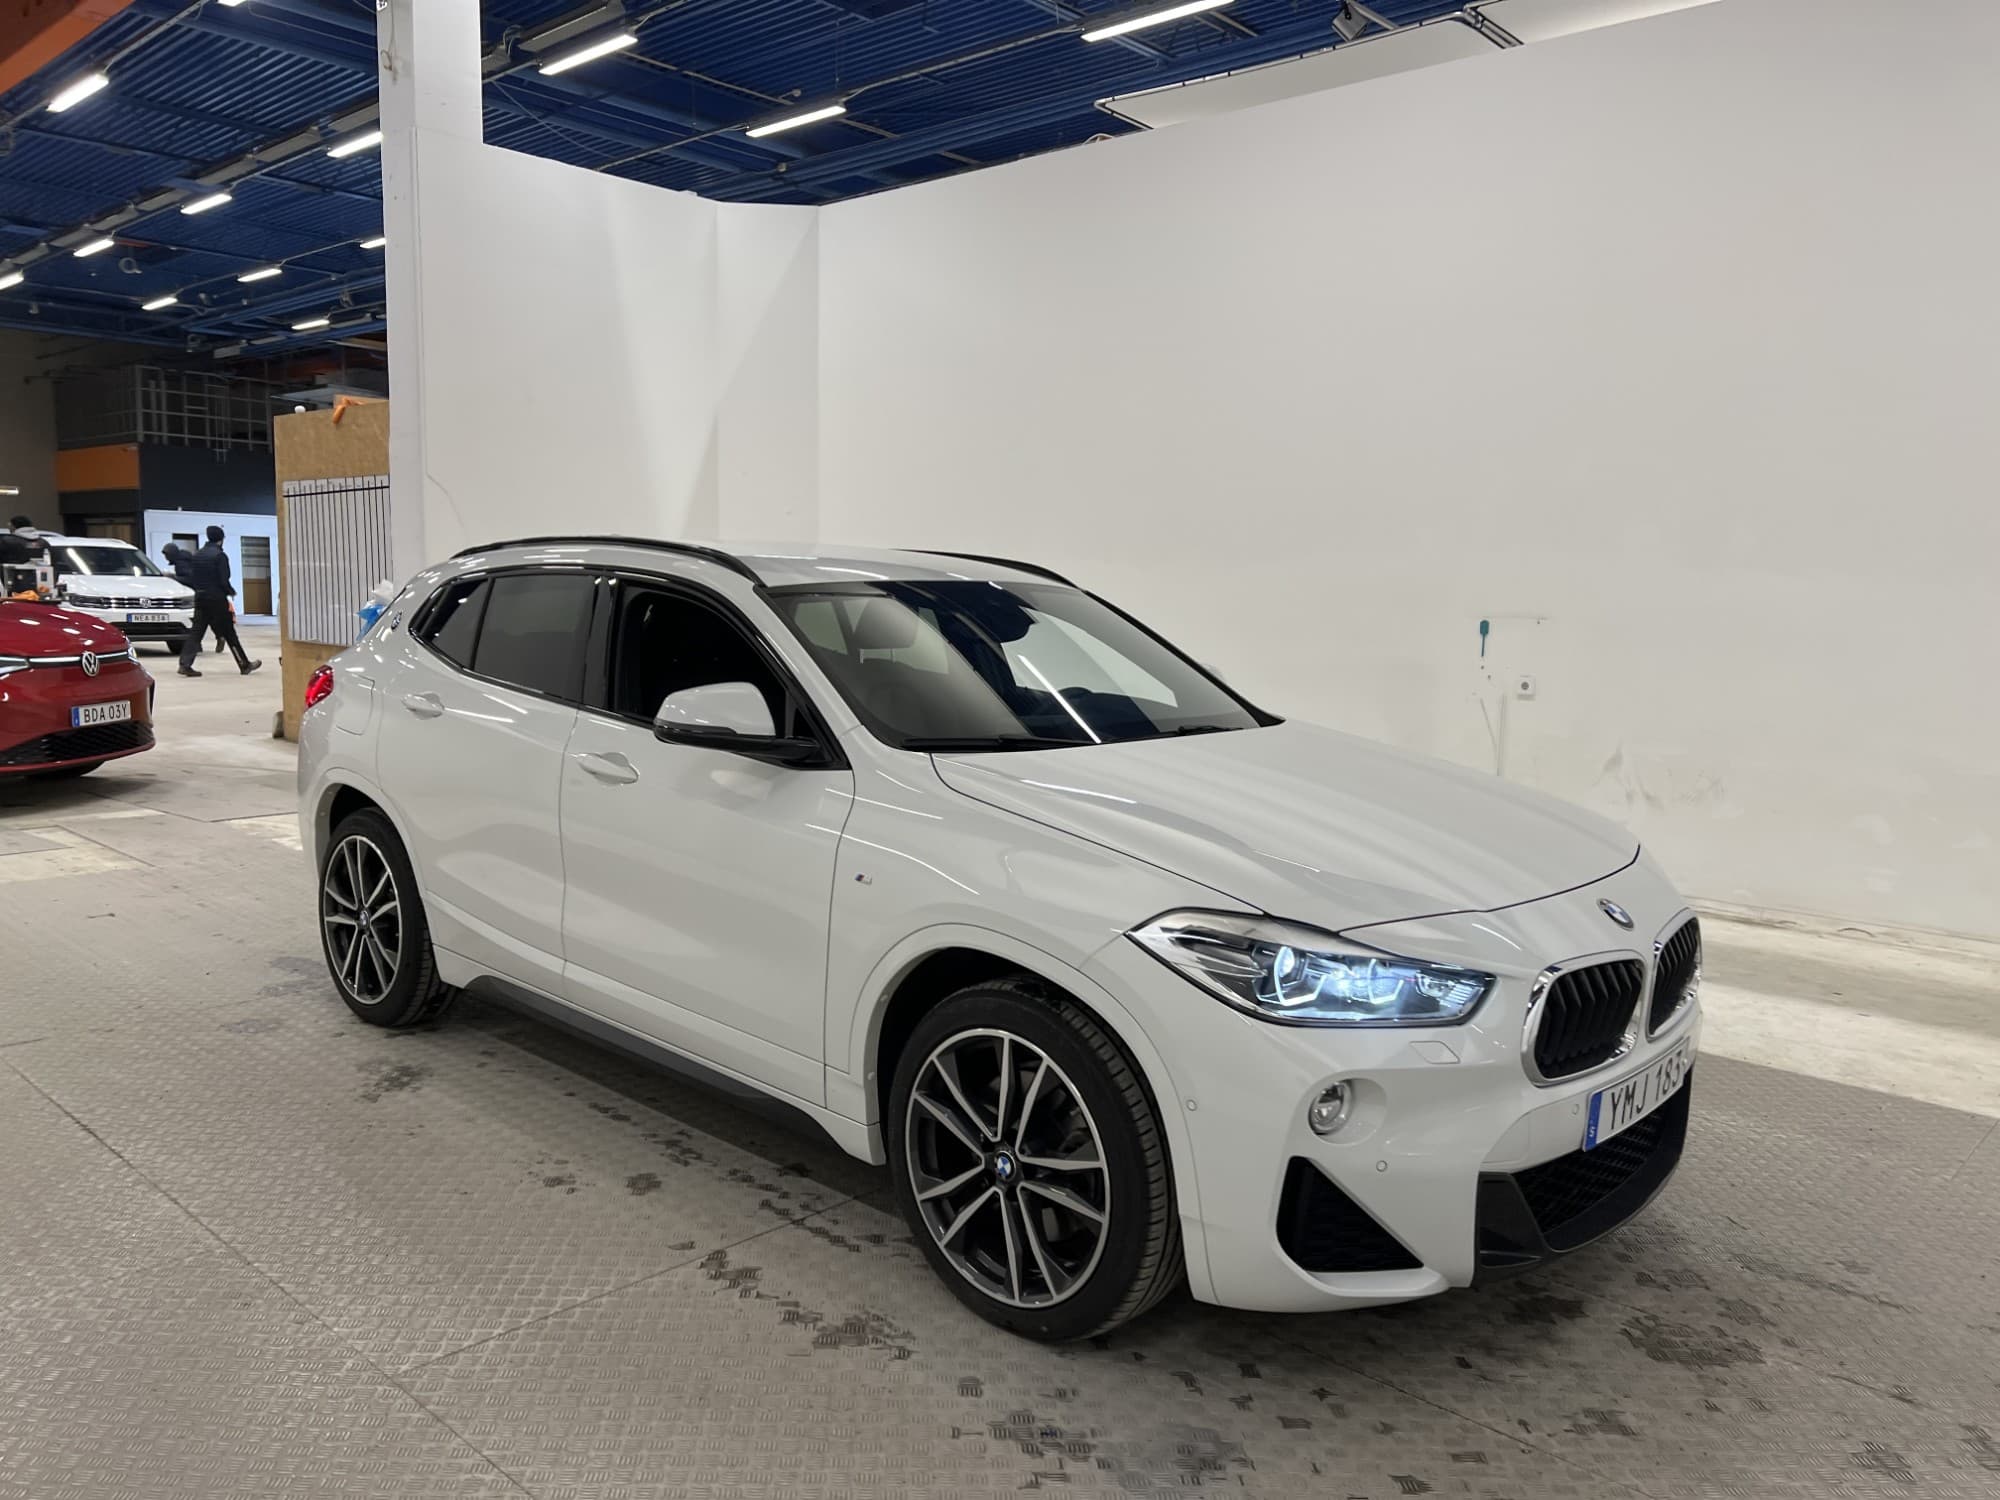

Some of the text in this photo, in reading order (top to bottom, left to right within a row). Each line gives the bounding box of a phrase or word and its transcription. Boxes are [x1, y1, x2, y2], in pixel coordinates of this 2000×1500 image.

[84, 703, 127, 723] BDA 03Y
[1611, 1073, 1649, 1130] YMJ
